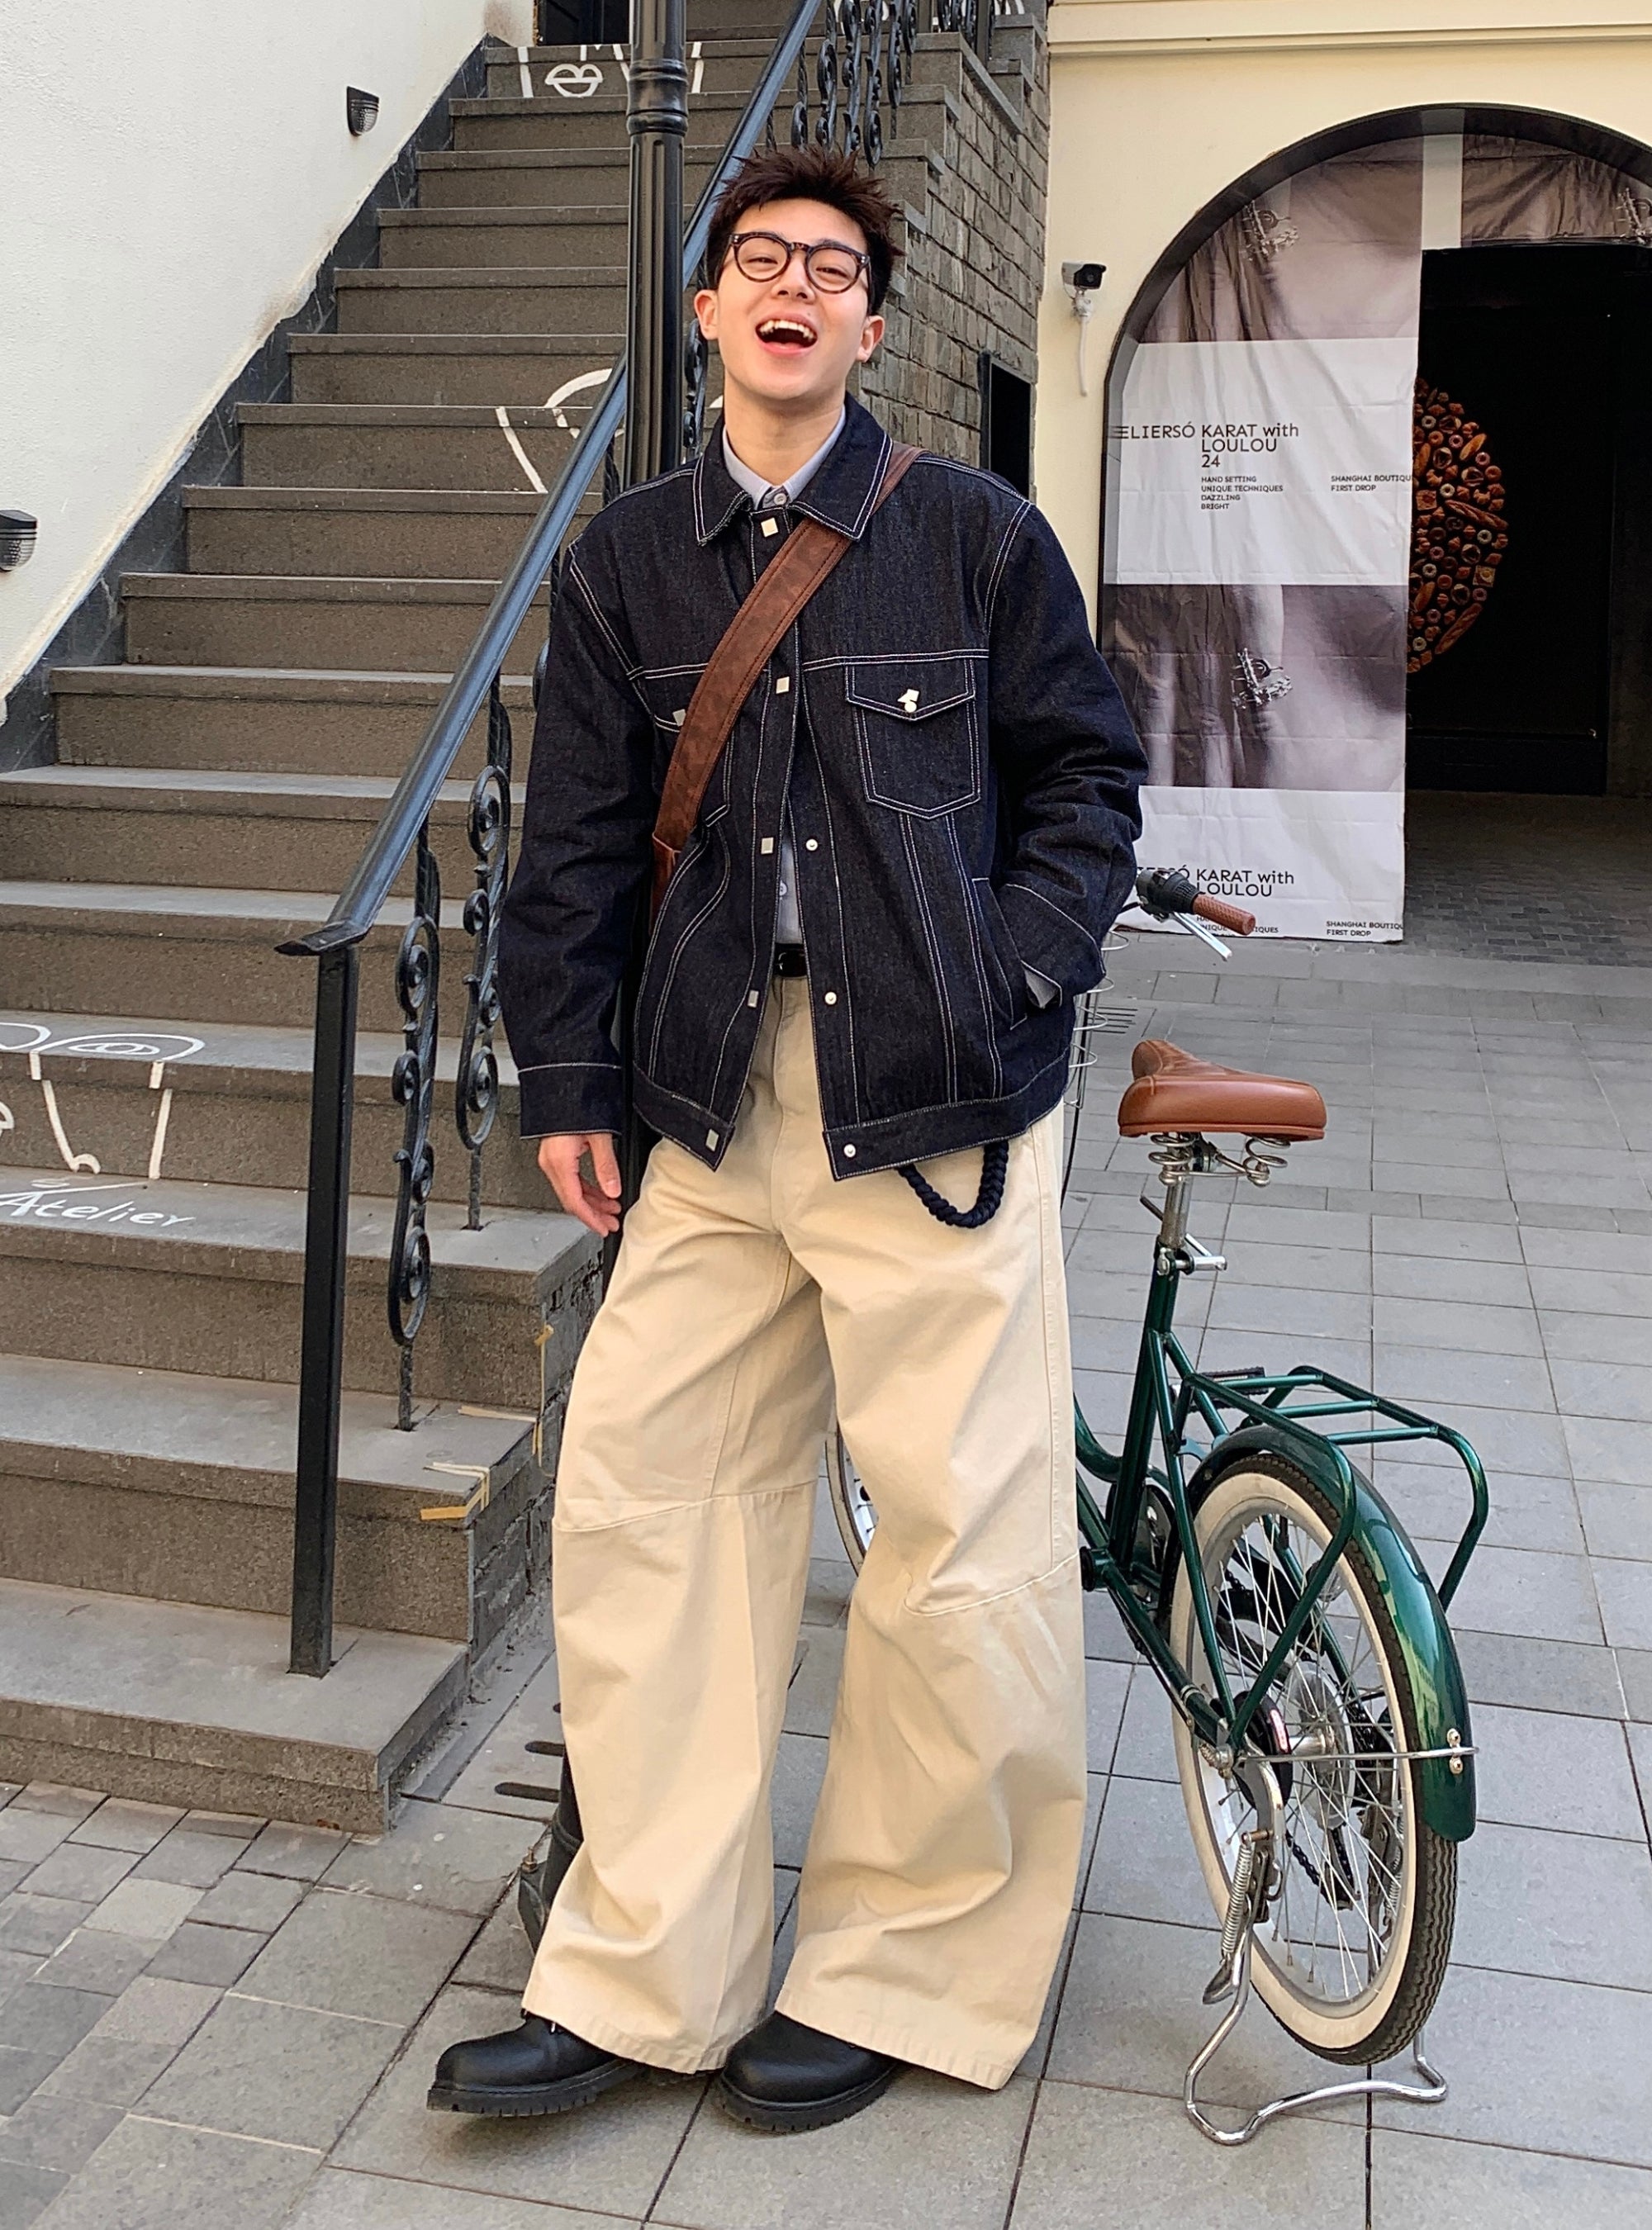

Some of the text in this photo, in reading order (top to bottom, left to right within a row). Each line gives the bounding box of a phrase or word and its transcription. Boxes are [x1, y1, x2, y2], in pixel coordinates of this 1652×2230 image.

[1201, 424, 1258, 438] KARAT
[1262, 422, 1299, 437] with
[1201, 438, 1277, 453] LOULOU
[1201, 454, 1221, 468] 24
[1234, 485, 1284, 493] TECHNIQUES
[1196, 869, 1253, 883] KARAT
[1257, 870, 1294, 885] with
[1196, 882, 1272, 897] LOULOU
[1326, 920, 1367, 928] SHANGHAI
[0, 1189, 196, 1226] Atelier
